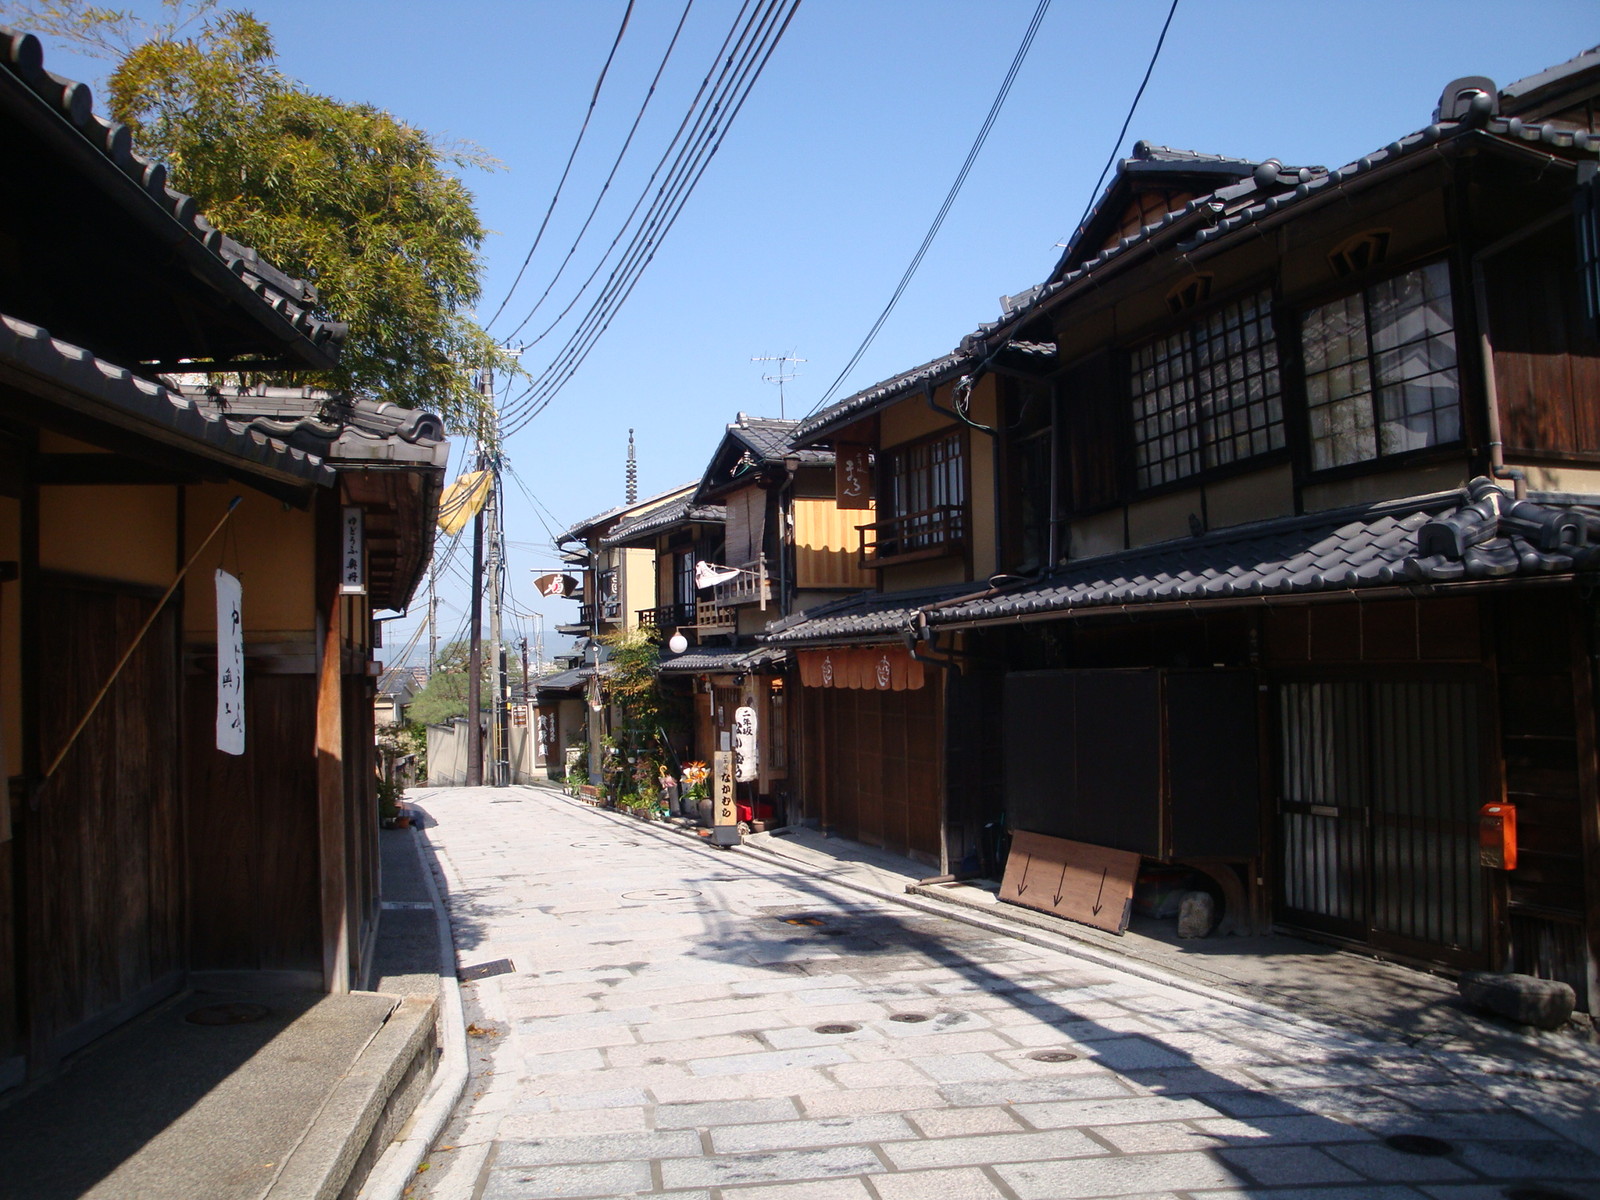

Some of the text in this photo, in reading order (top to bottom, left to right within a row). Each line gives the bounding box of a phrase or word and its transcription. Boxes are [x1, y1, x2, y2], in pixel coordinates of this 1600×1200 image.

[742, 709, 754, 736] 二年坂
[720, 772, 732, 818] なかむら
